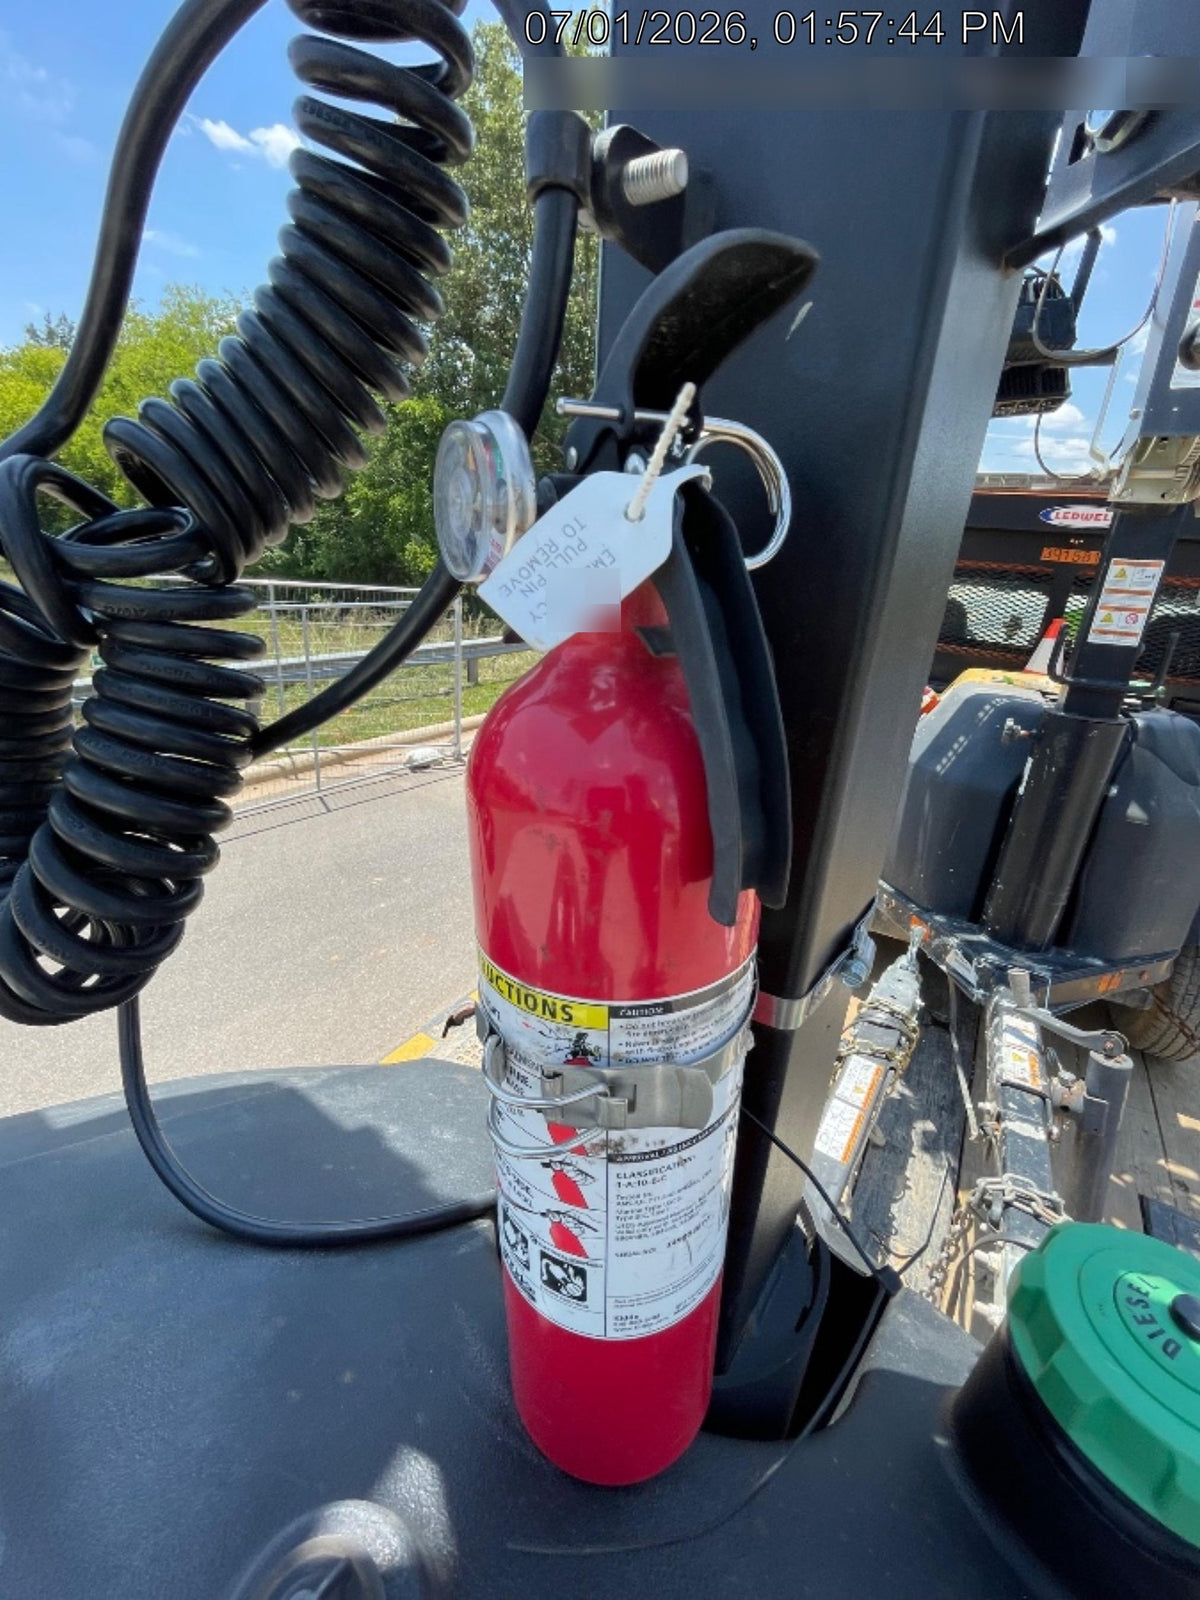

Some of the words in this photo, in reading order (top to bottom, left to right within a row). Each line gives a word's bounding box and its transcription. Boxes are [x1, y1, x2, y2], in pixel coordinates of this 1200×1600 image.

[562, 517, 588, 538] TO
[1053, 511, 1111, 522] LEDWEL
[499, 539, 559, 597] REMOVE
[547, 538, 588, 568] PULL
[520, 575, 548, 598] PIN
[483, 959, 574, 1023] UCTIONS
[1126, 1275, 1184, 1361] DIESEL
